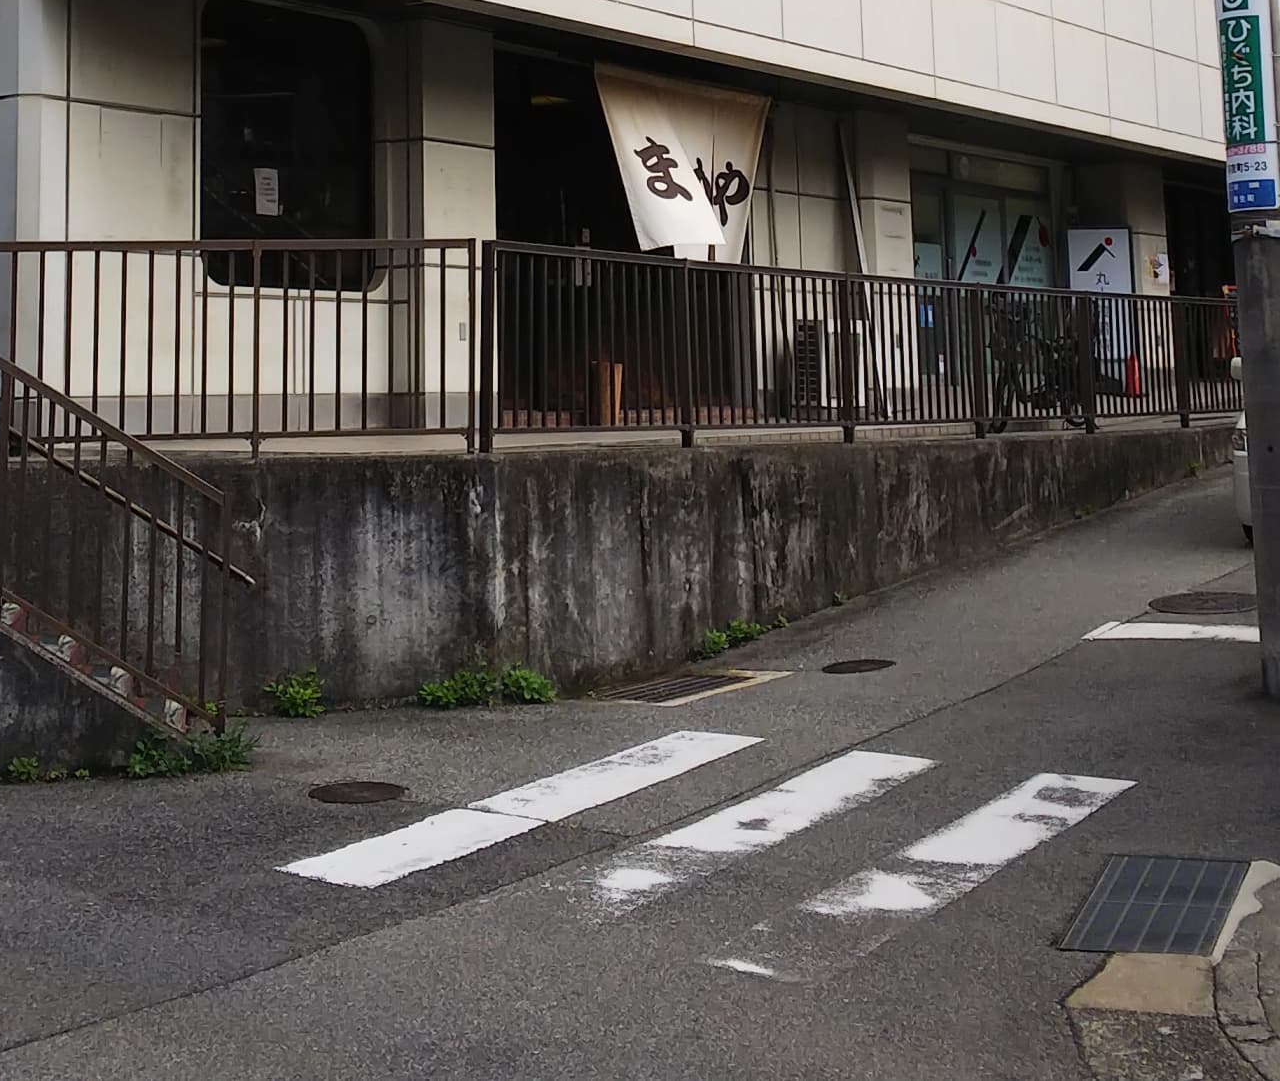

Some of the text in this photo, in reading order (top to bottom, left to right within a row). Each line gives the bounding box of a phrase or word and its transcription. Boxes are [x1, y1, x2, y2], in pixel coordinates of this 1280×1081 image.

[1227, 19, 1257, 141] ひぐち内科
